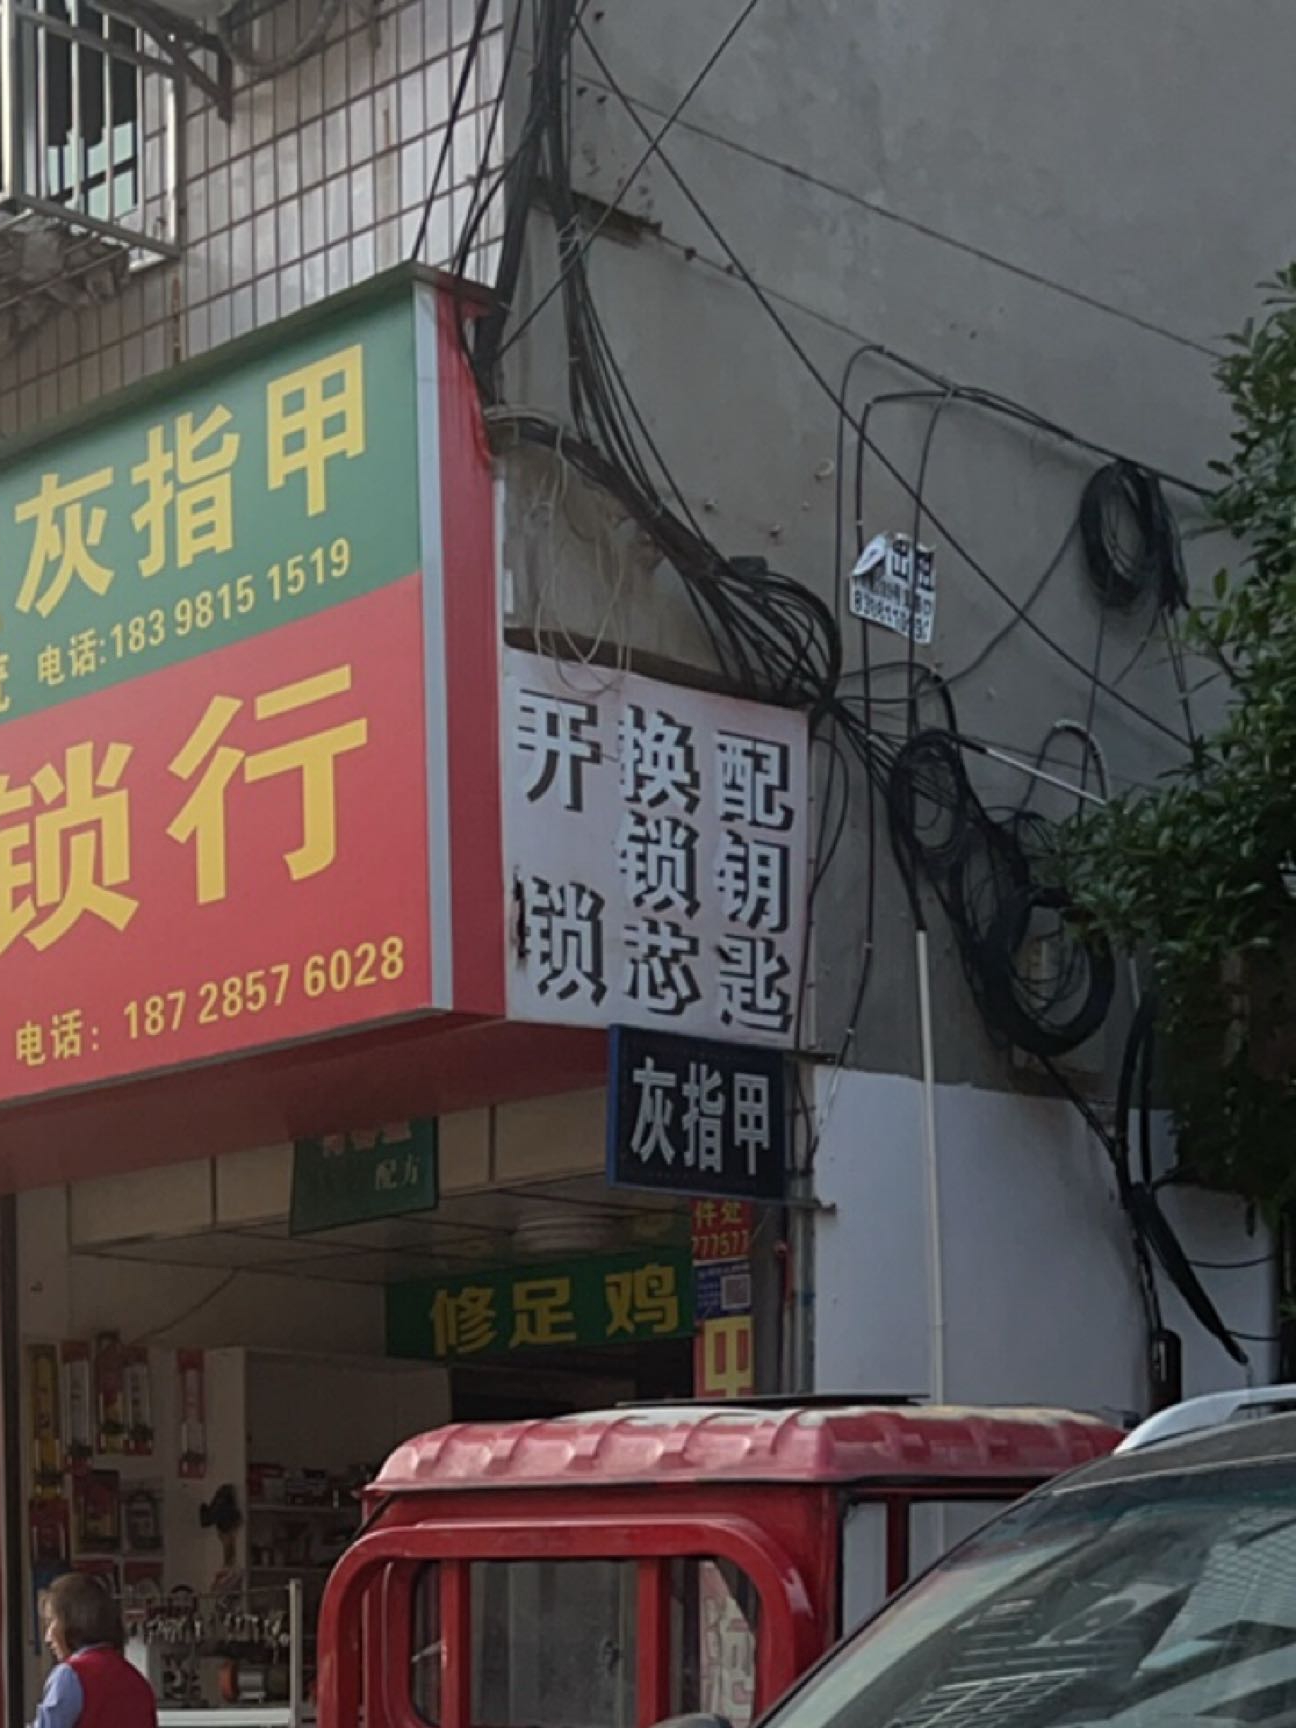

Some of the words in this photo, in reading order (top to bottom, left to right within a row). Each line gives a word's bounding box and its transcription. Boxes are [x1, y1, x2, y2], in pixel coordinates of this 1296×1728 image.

[175, 576, 255, 636] 9815
[267, 538, 351, 600] 1519
[518, 689, 607, 1007] 开锁
[618, 703, 702, 1016] 换锁芯
[717, 729, 795, 1034] 配钥匙
[124, 990, 186, 1039] 187
[198, 963, 290, 1024] 2857
[304, 936, 404, 997] 6028
[631, 1055, 770, 1176] 灰指甲
[430, 1276, 577, 1358] 修足
[604, 1262, 680, 1337] 鸡
